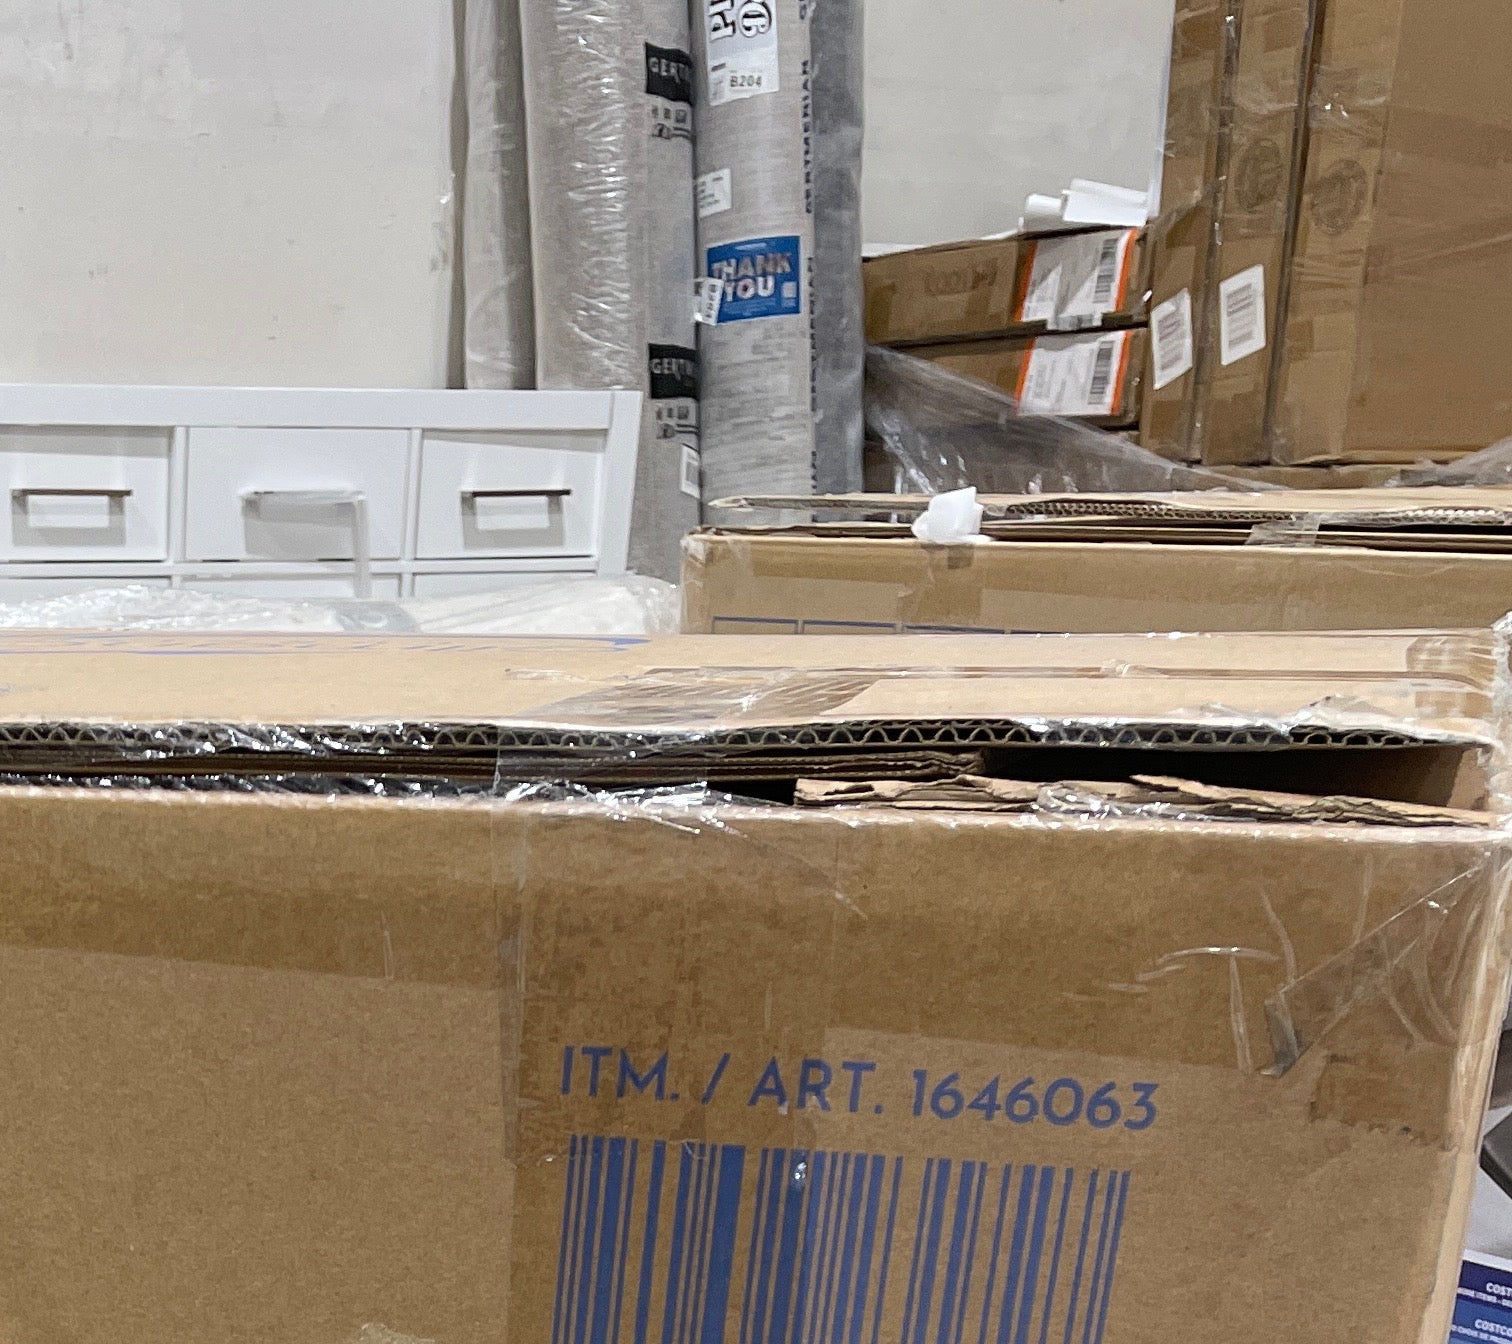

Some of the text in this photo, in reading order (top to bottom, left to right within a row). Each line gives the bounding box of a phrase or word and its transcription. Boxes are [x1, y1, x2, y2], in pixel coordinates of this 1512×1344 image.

[711, 252, 790, 280] THANK
[724, 275, 775, 302] YOU
[562, 1045, 1159, 1130] ITM. / ART. 1646063
